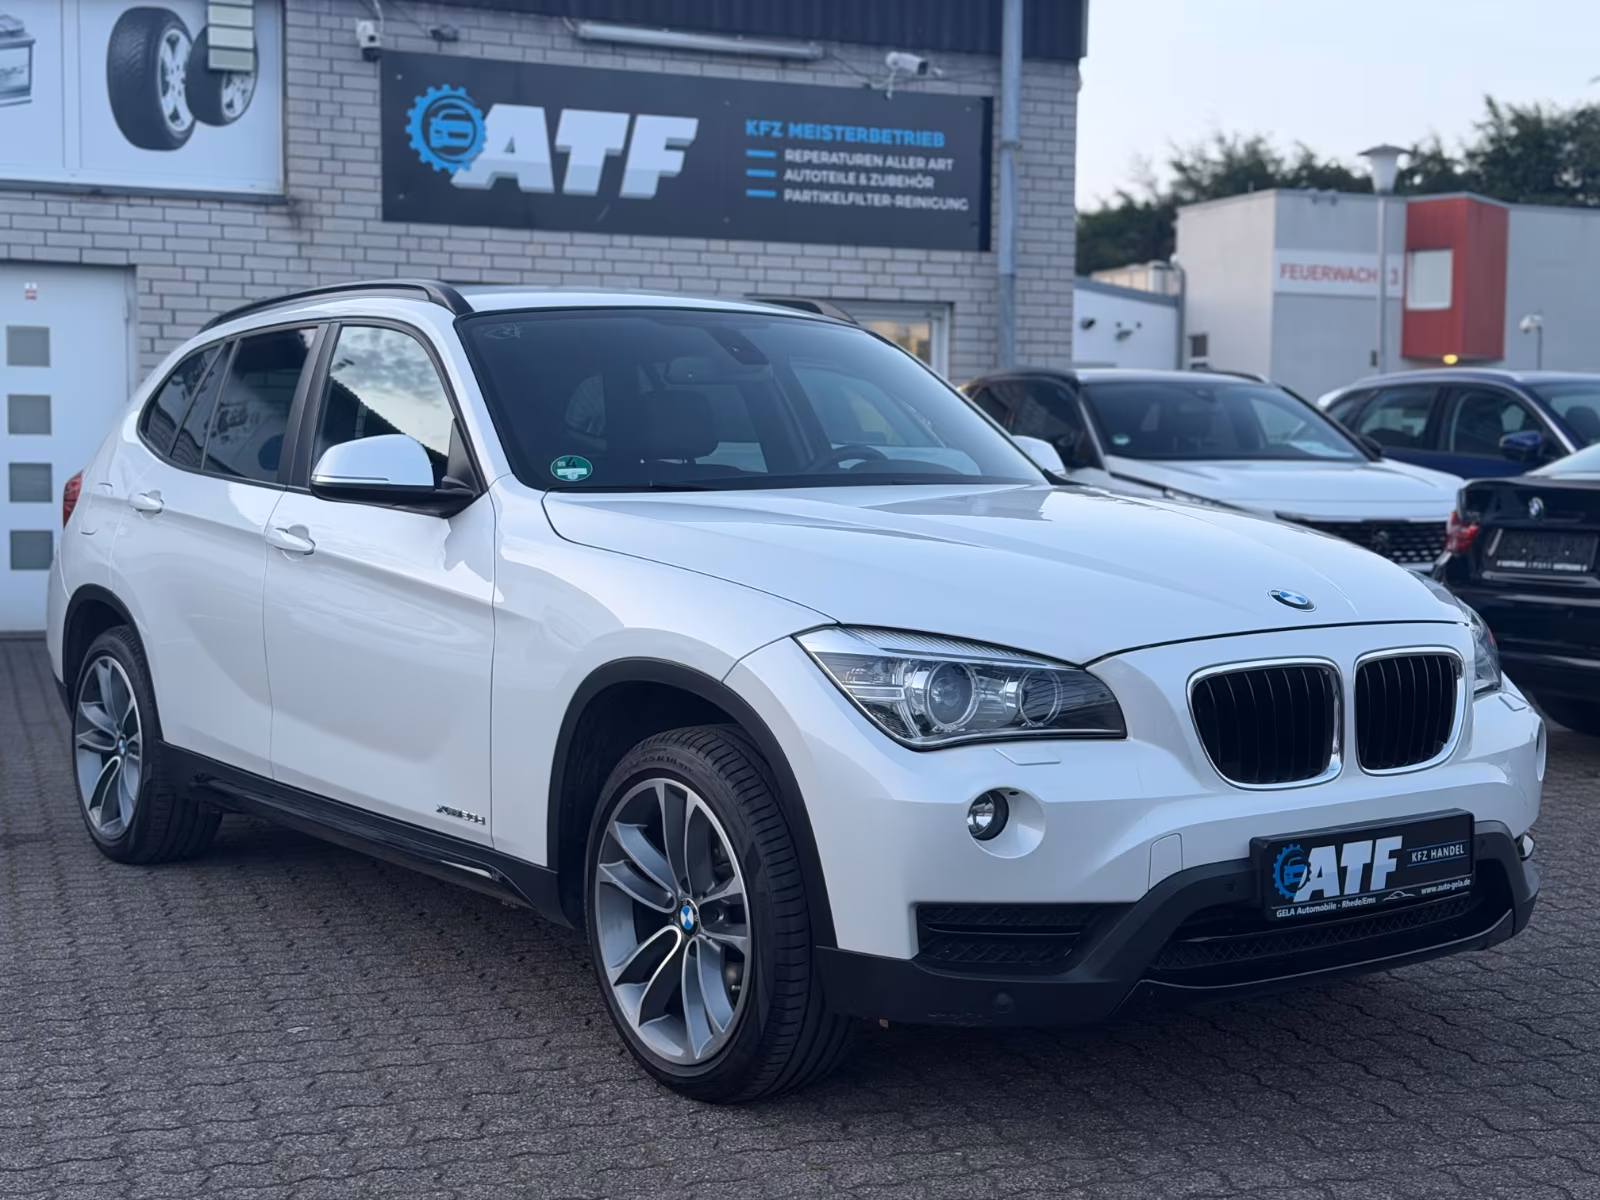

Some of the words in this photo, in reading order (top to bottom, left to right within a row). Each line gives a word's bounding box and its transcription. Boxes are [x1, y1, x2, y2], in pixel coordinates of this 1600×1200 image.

[745, 119, 783, 138] KFZ
[788, 122, 945, 148] MEISTERBETRIEB
[450, 103, 699, 199] ATF
[784, 148, 884, 168] REPERATUREN
[885, 154, 927, 170] ALLER
[927, 157, 954, 172] ART
[784, 168, 856, 186] AUTOTEILE
[858, 174, 867, 187] &
[869, 173, 934, 189] ZUBEHÖR
[1280, 263, 1378, 285] FEUERWACH
[1411, 849, 1428, 863] KFZ
[1430, 843, 1465, 862] HANDEL
[1293, 836, 1403, 903] ATF
[1421, 878, 1471, 895] www.auto-gela.de
[1276, 907, 1296, 918] GELA
[1296, 901, 1337, 916] Automobile
[1342, 896, 1376, 909] Rhede/Ems
